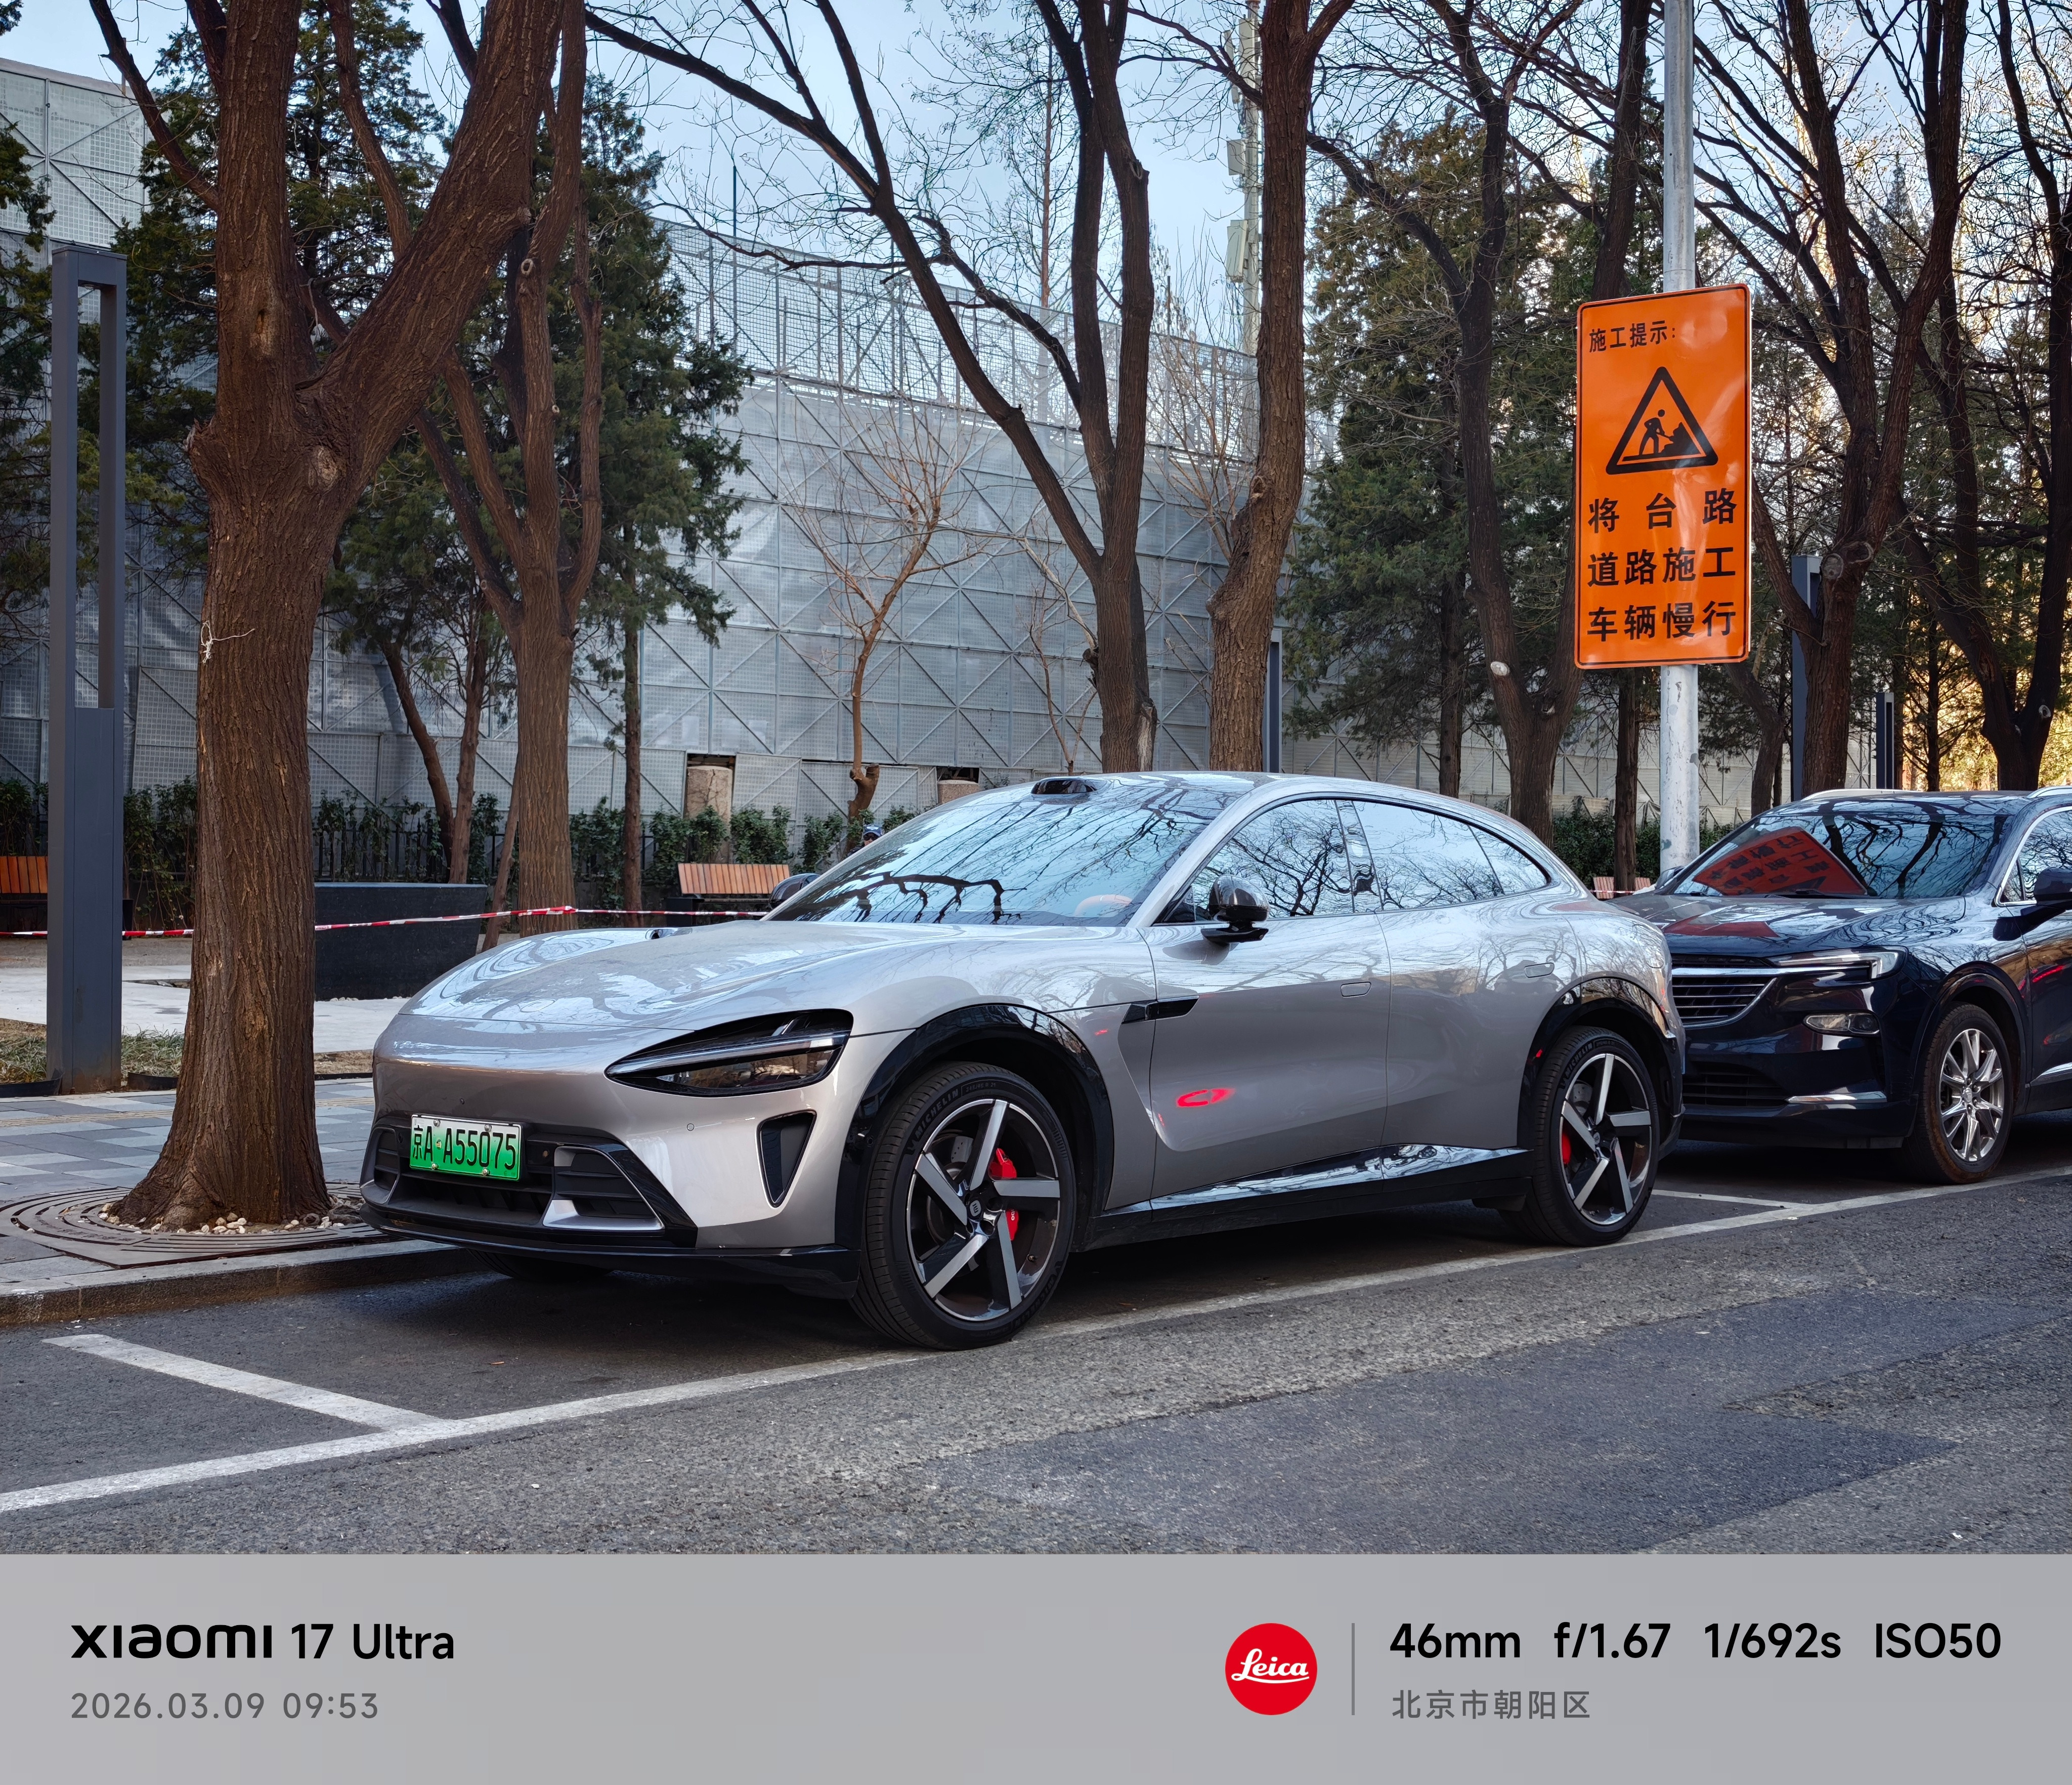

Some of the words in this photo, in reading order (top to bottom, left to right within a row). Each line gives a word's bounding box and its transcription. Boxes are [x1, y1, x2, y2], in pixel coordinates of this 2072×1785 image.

[1587, 547, 1737, 587] 道路施工
[1587, 601, 1737, 642] 车辆慢行
[1565, 1042, 1593, 1078] MICHELIN
[914, 1088, 959, 1138] MICHELIN
